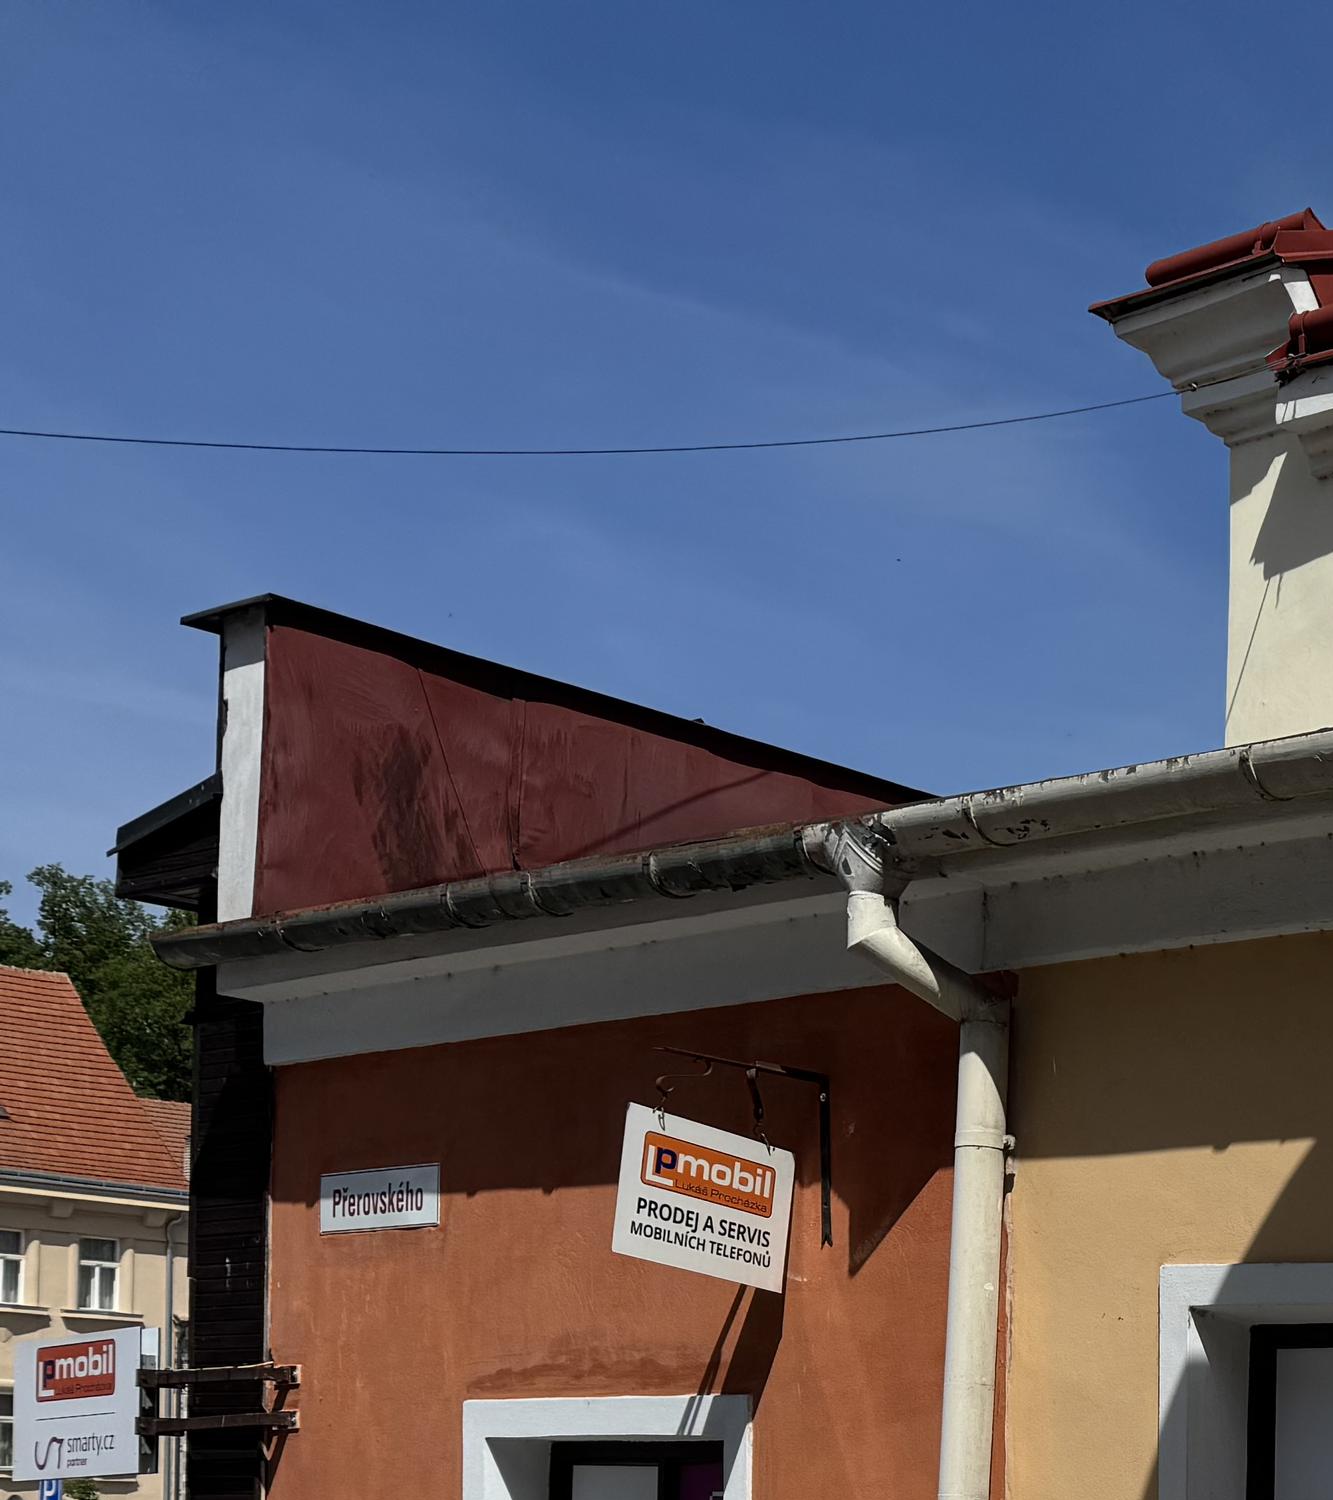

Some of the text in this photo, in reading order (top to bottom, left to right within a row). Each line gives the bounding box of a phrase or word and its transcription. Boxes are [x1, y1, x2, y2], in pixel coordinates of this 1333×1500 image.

[332, 1180, 424, 1219] Přerovského
[636, 1197, 771, 1248] PRODEJ A SERVIS
[630, 1221, 771, 1268] MOBILNÍCH TELEFONŮ
[67, 1433, 115, 1456] smarty.cz
